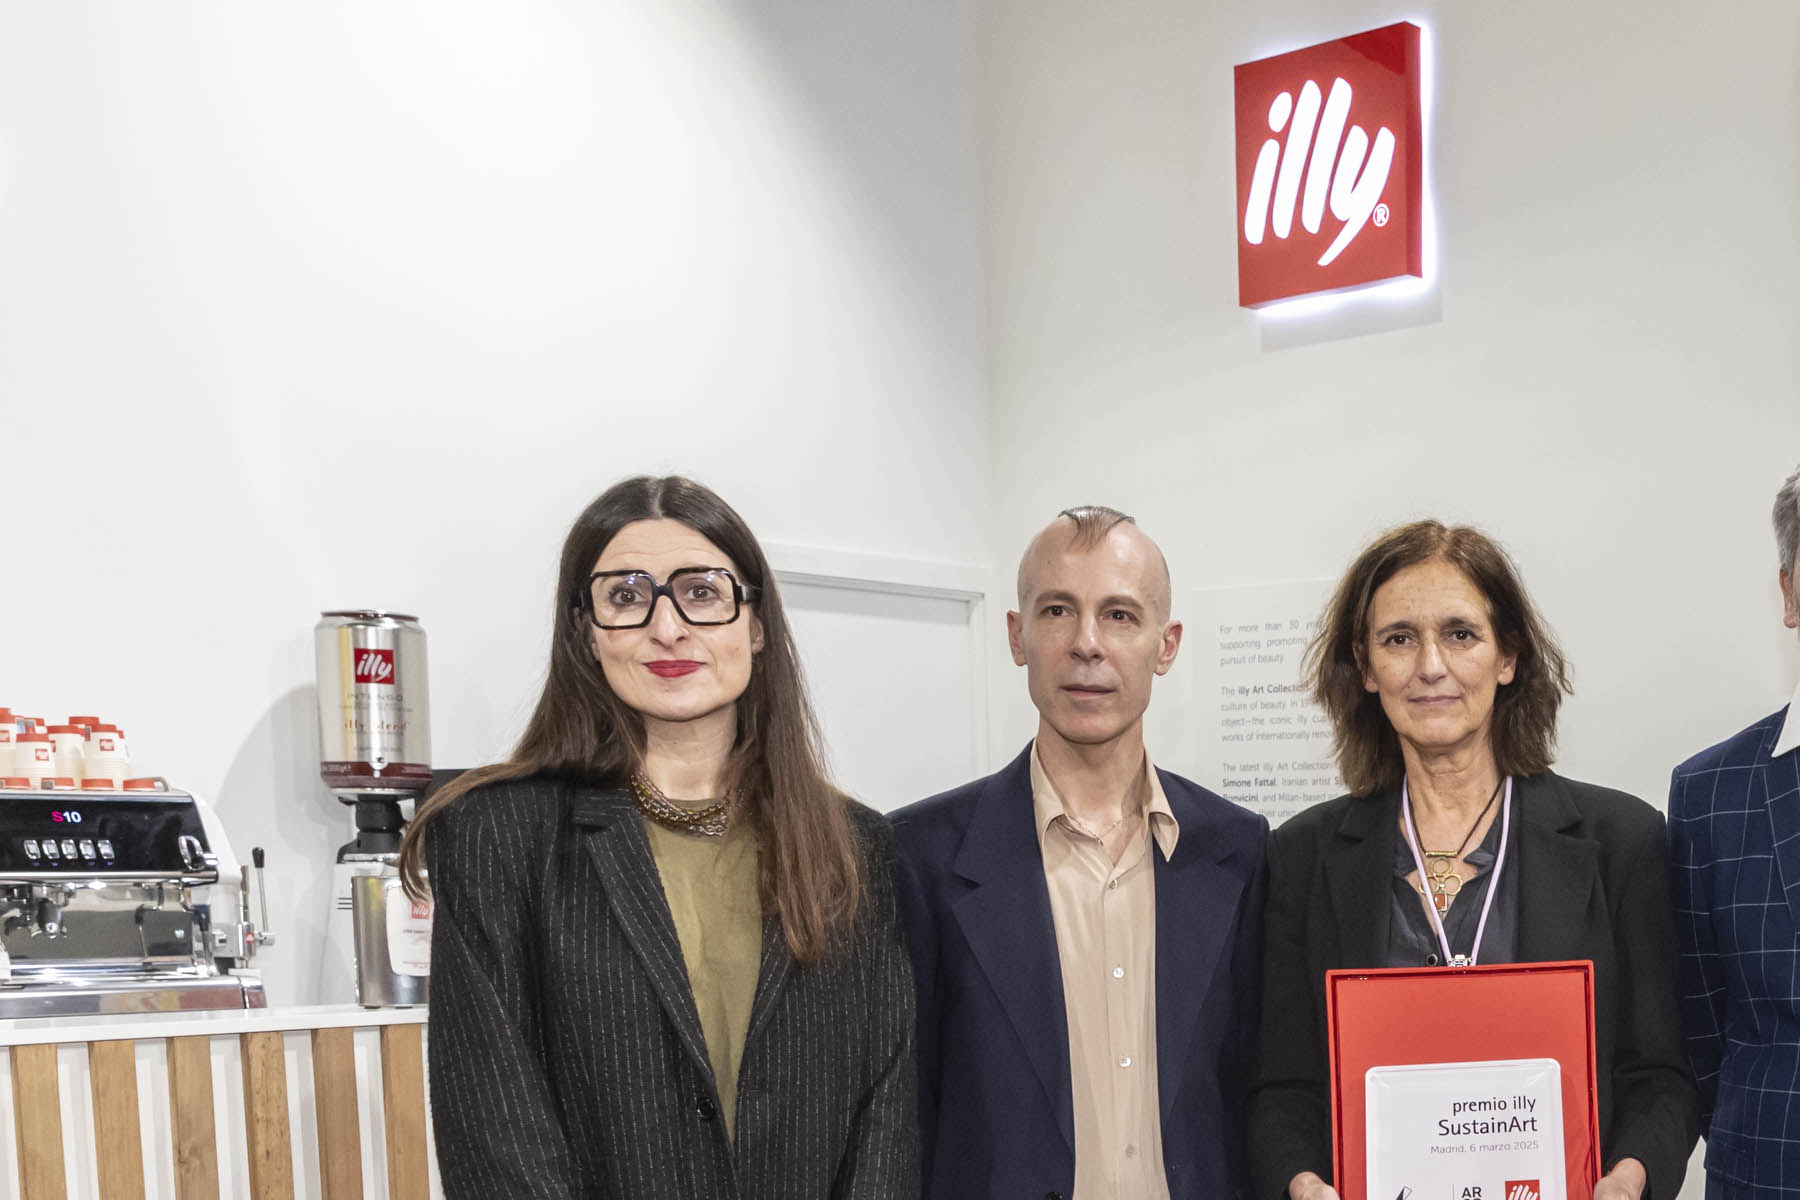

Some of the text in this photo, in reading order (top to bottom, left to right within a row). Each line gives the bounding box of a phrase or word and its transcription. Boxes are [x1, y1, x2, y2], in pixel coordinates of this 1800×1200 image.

[1221, 777, 1252, 788] Simone
[50, 811, 82, 823] S10
[1452, 1095, 1536, 1117] premio illy
[1438, 1116, 1538, 1136] SustainArt
[1469, 1143, 1477, 1152] 6
[1479, 1143, 1511, 1152] marzo
[1513, 1140, 1540, 1151] 2025
[1461, 1186, 1483, 1198] AR
